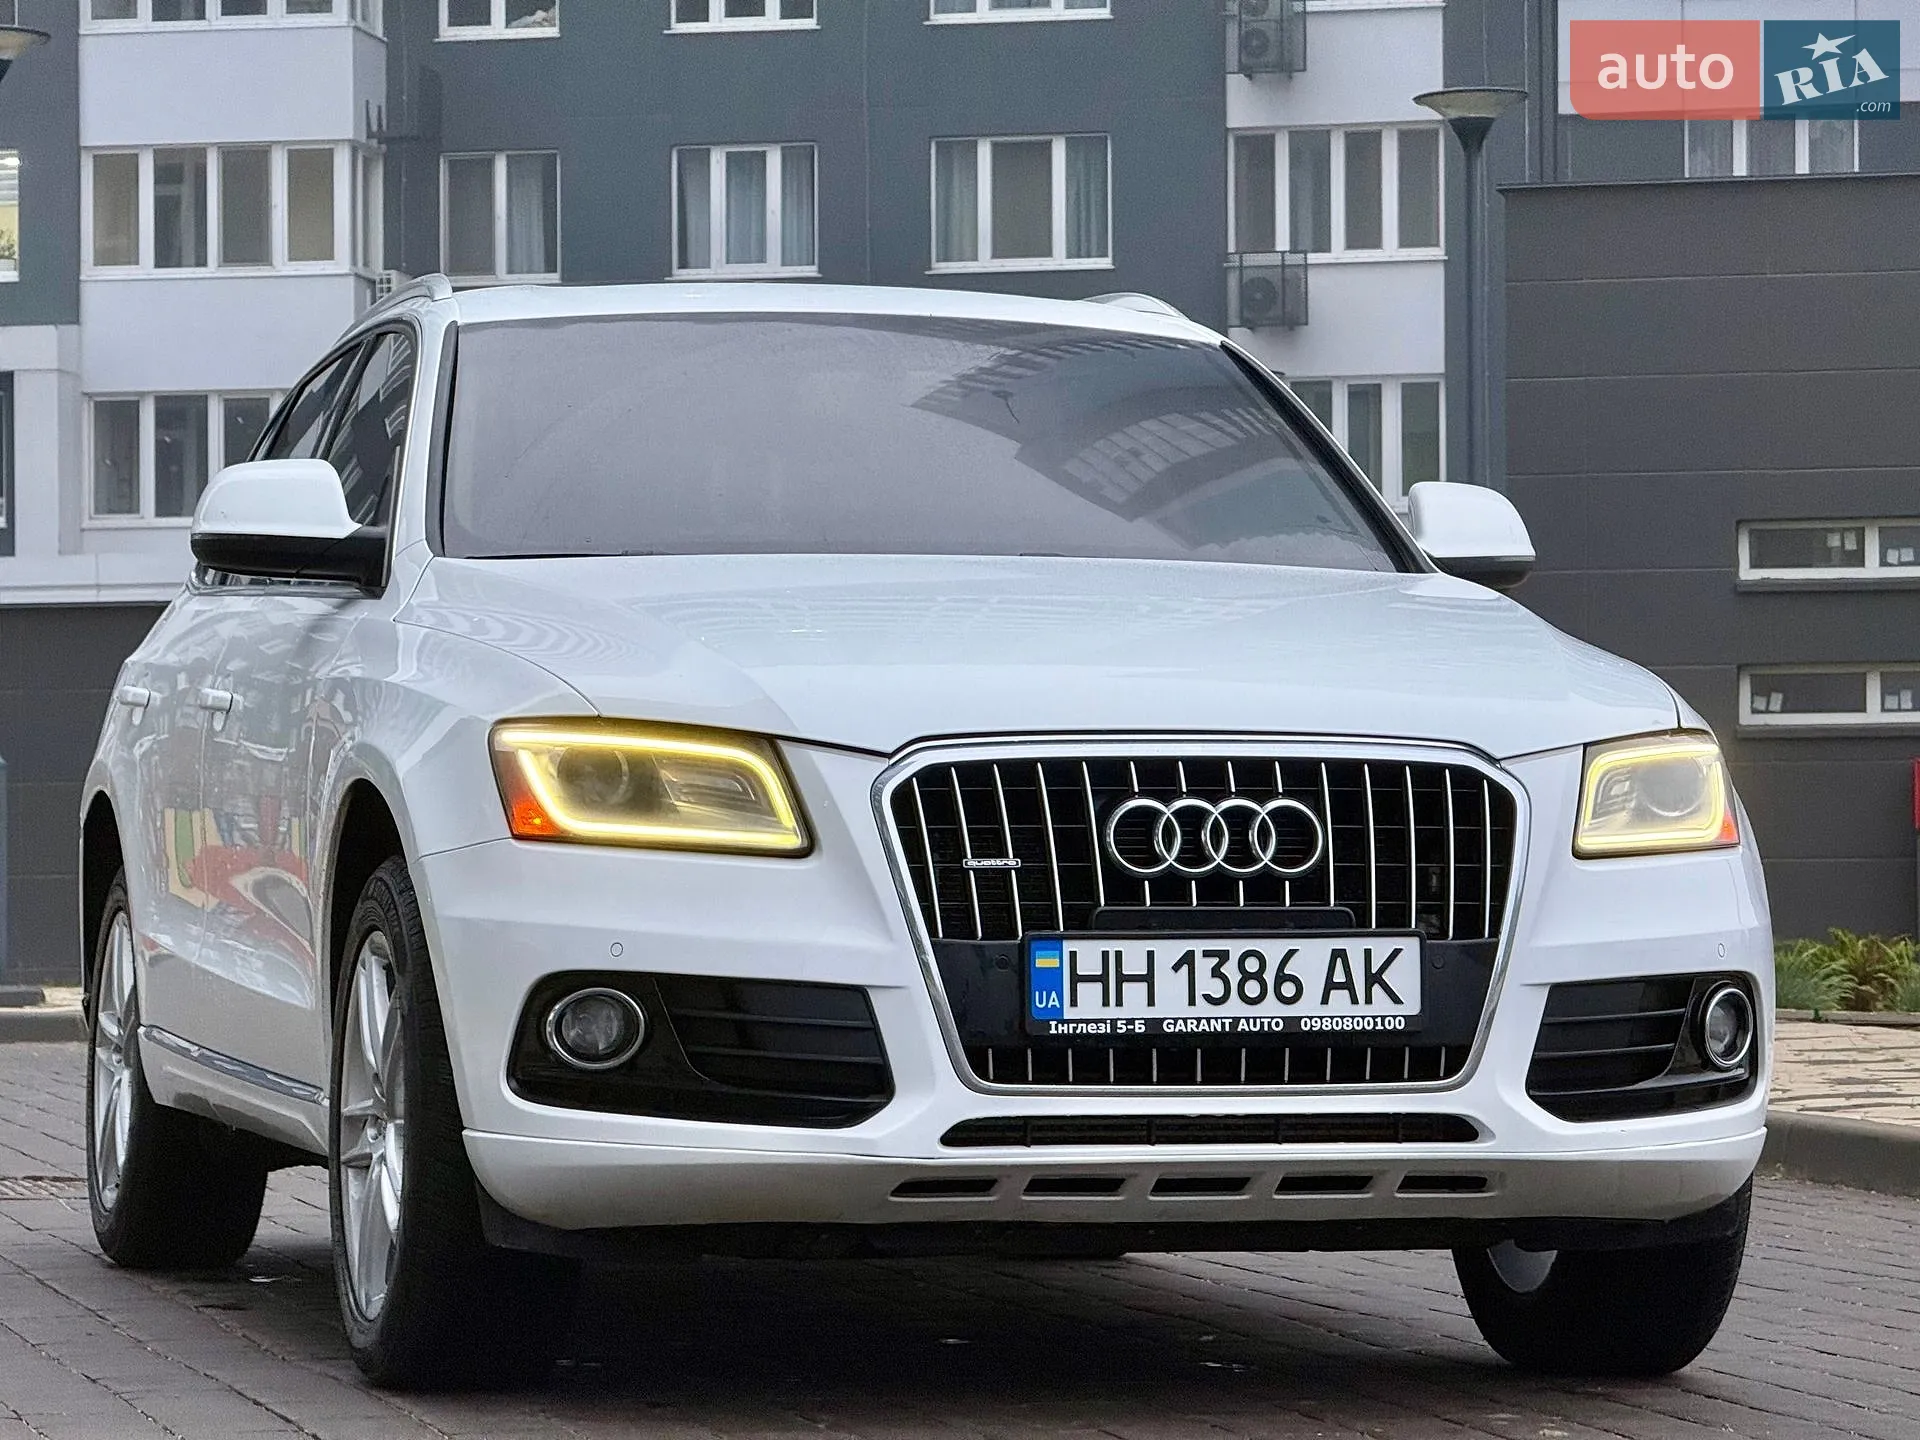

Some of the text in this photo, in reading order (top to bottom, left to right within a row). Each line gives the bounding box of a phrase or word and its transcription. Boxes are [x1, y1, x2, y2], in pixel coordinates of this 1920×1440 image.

[1170, 948, 1304, 1006] 1386
[1320, 947, 1405, 1006] AK
[1035, 990, 1060, 1009] UA
[1163, 1018, 1284, 1033] GARANT AUTO
[1301, 1016, 1406, 1031] 0980800100
